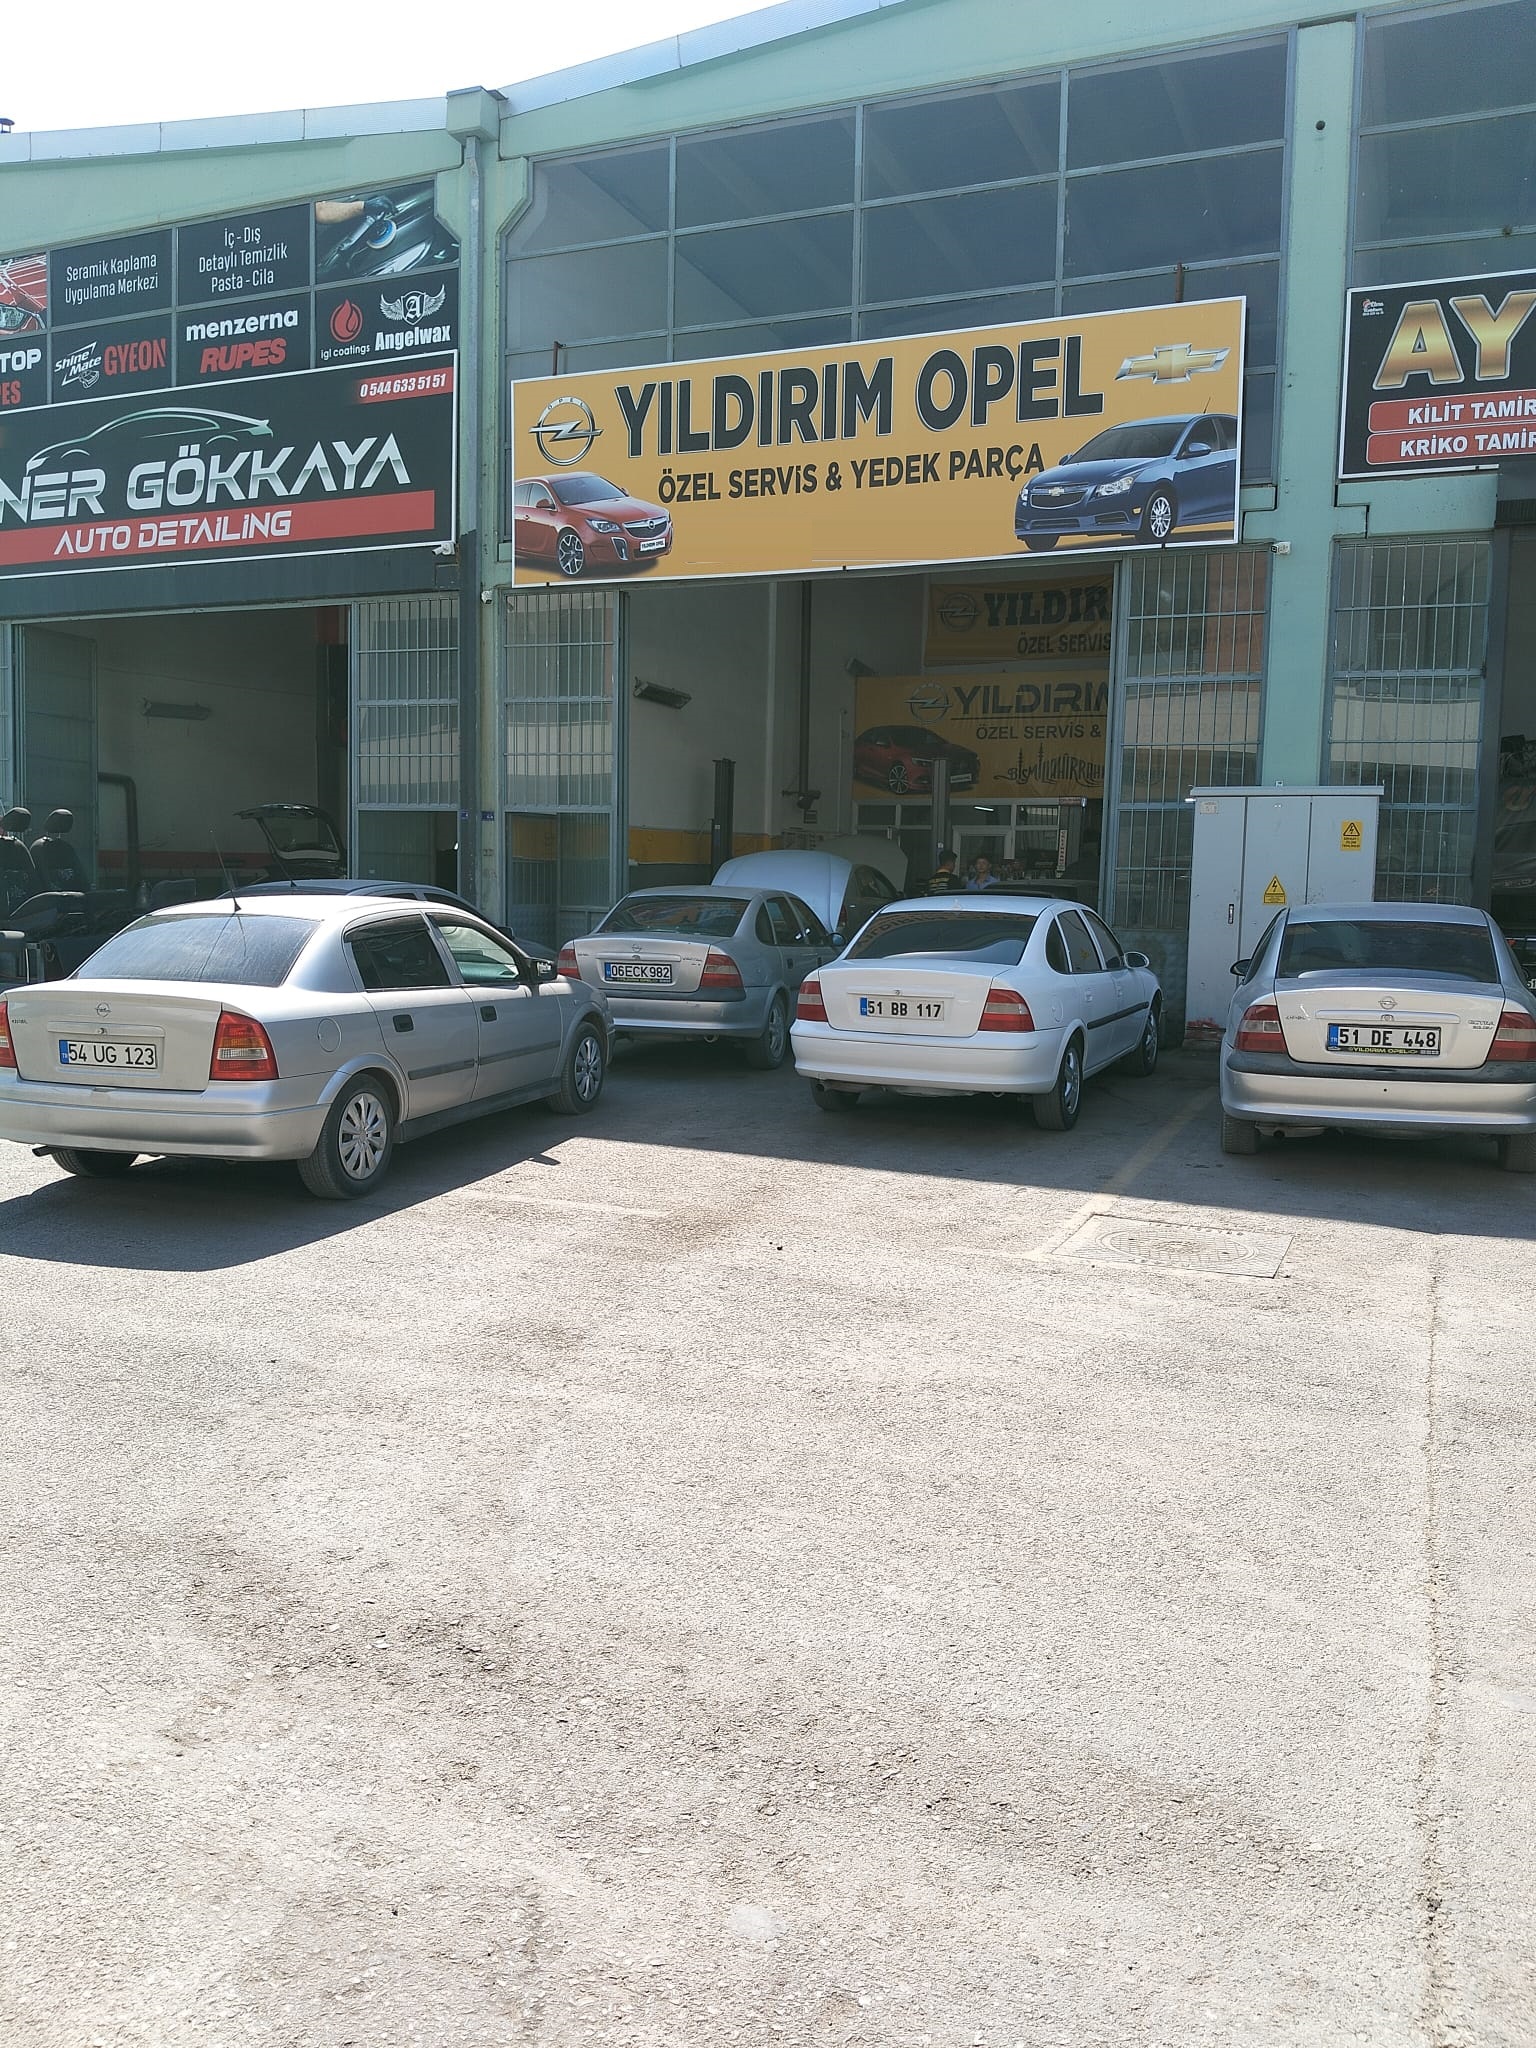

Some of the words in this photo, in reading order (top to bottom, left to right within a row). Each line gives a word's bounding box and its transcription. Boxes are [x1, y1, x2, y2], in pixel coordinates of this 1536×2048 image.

[224, 227, 235, 248] İç
[244, 226, 261, 244] Dış
[66, 260, 109, 282] Seramik
[110, 254, 157, 275] Kaplama
[199, 252, 237, 273] Detaylı
[240, 242, 288, 266] Temizlik
[65, 282, 116, 306] Uygulama
[117, 272, 159, 295] Merkezi
[211, 273, 243, 293] Pasta
[252, 268, 274, 286] Cila
[186, 309, 298, 342] menzerna
[374, 325, 451, 351] Angelwax
[321, 349, 332, 361] igl
[333, 344, 371, 357] coatings
[1373, 289, 1536, 390] AY
[54, 351, 91, 372] Shine
[69, 356, 102, 378] Mate
[104, 338, 166, 376] GYEON
[200, 337, 287, 374] RUPES
[0, 380, 21, 406] ES
[614, 356, 894, 458] YILDIRIM
[915, 335, 1105, 432] OPEL
[1408, 401, 1464, 424] KİLİT
[1470, 395, 1536, 420] TAMİR
[1400, 434, 1468, 457] KRİKO
[126, 432, 412, 510] GÖKKAYA
[658, 468, 721, 503] ÖZEL
[728, 463, 818, 499] SERVİS
[825, 461, 842, 492] &
[850, 452, 941, 489] YEDEK
[949, 443, 1045, 482] PARÇA
[54, 525, 131, 555] AUTO
[1017, 631, 1055, 654] ÖZEL
[976, 723, 1018, 740] ÖZEL
[1023, 720, 1084, 739] SERVİS
[1090, 725, 1102, 738] &
[867, 1000, 883, 1015] 51
[891, 1002, 908, 1016] BB
[916, 1003, 941, 1018] 117
[1339, 1028, 1359, 1044] 51
[1371, 1029, 1393, 1046] DE
[1403, 1031, 1436, 1048] 448
[68, 1043, 87, 1062] 54
[93, 1045, 117, 1063] UG
[125, 1047, 154, 1066] 123
